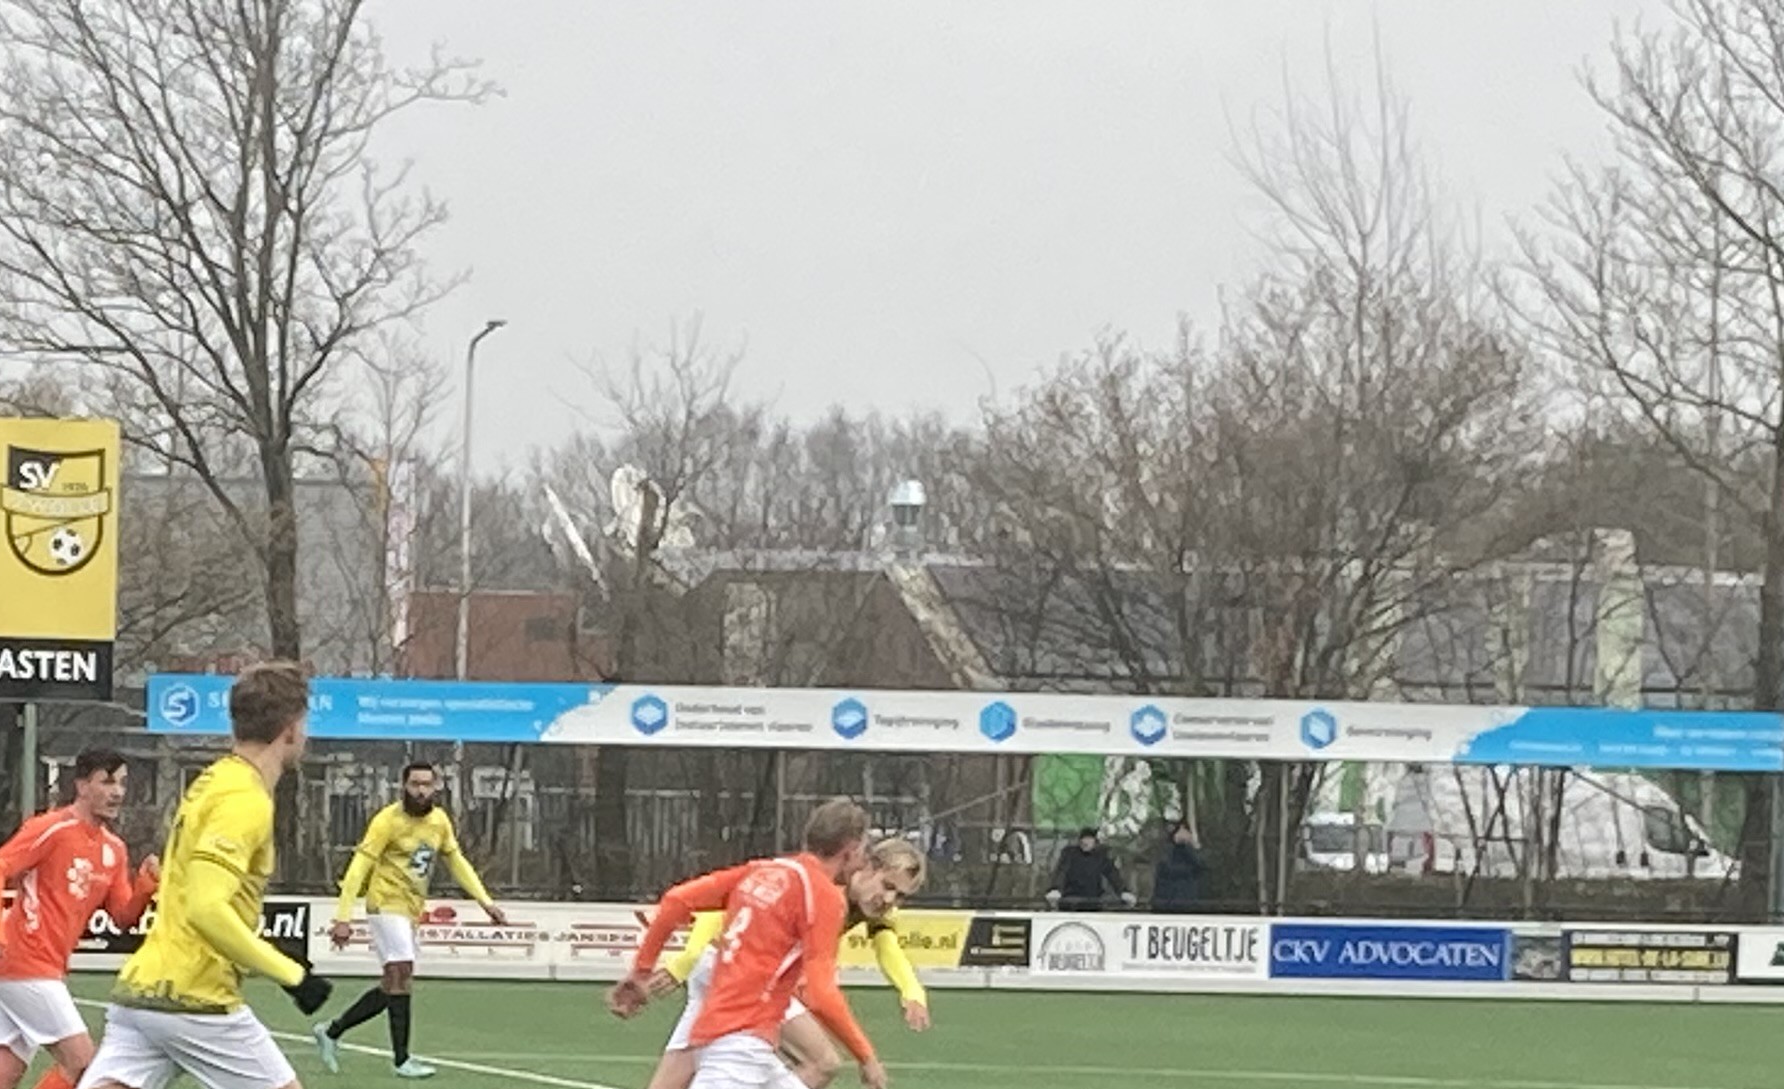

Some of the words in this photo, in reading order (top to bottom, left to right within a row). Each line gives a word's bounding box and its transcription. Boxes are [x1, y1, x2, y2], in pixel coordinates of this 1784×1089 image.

[18, 460, 61, 489] SV
[1147, 925, 1259, 962] BEUGELTJE
[1272, 939, 1331, 964] CKV
[1337, 940, 1501, 967] ADVOCATEN
